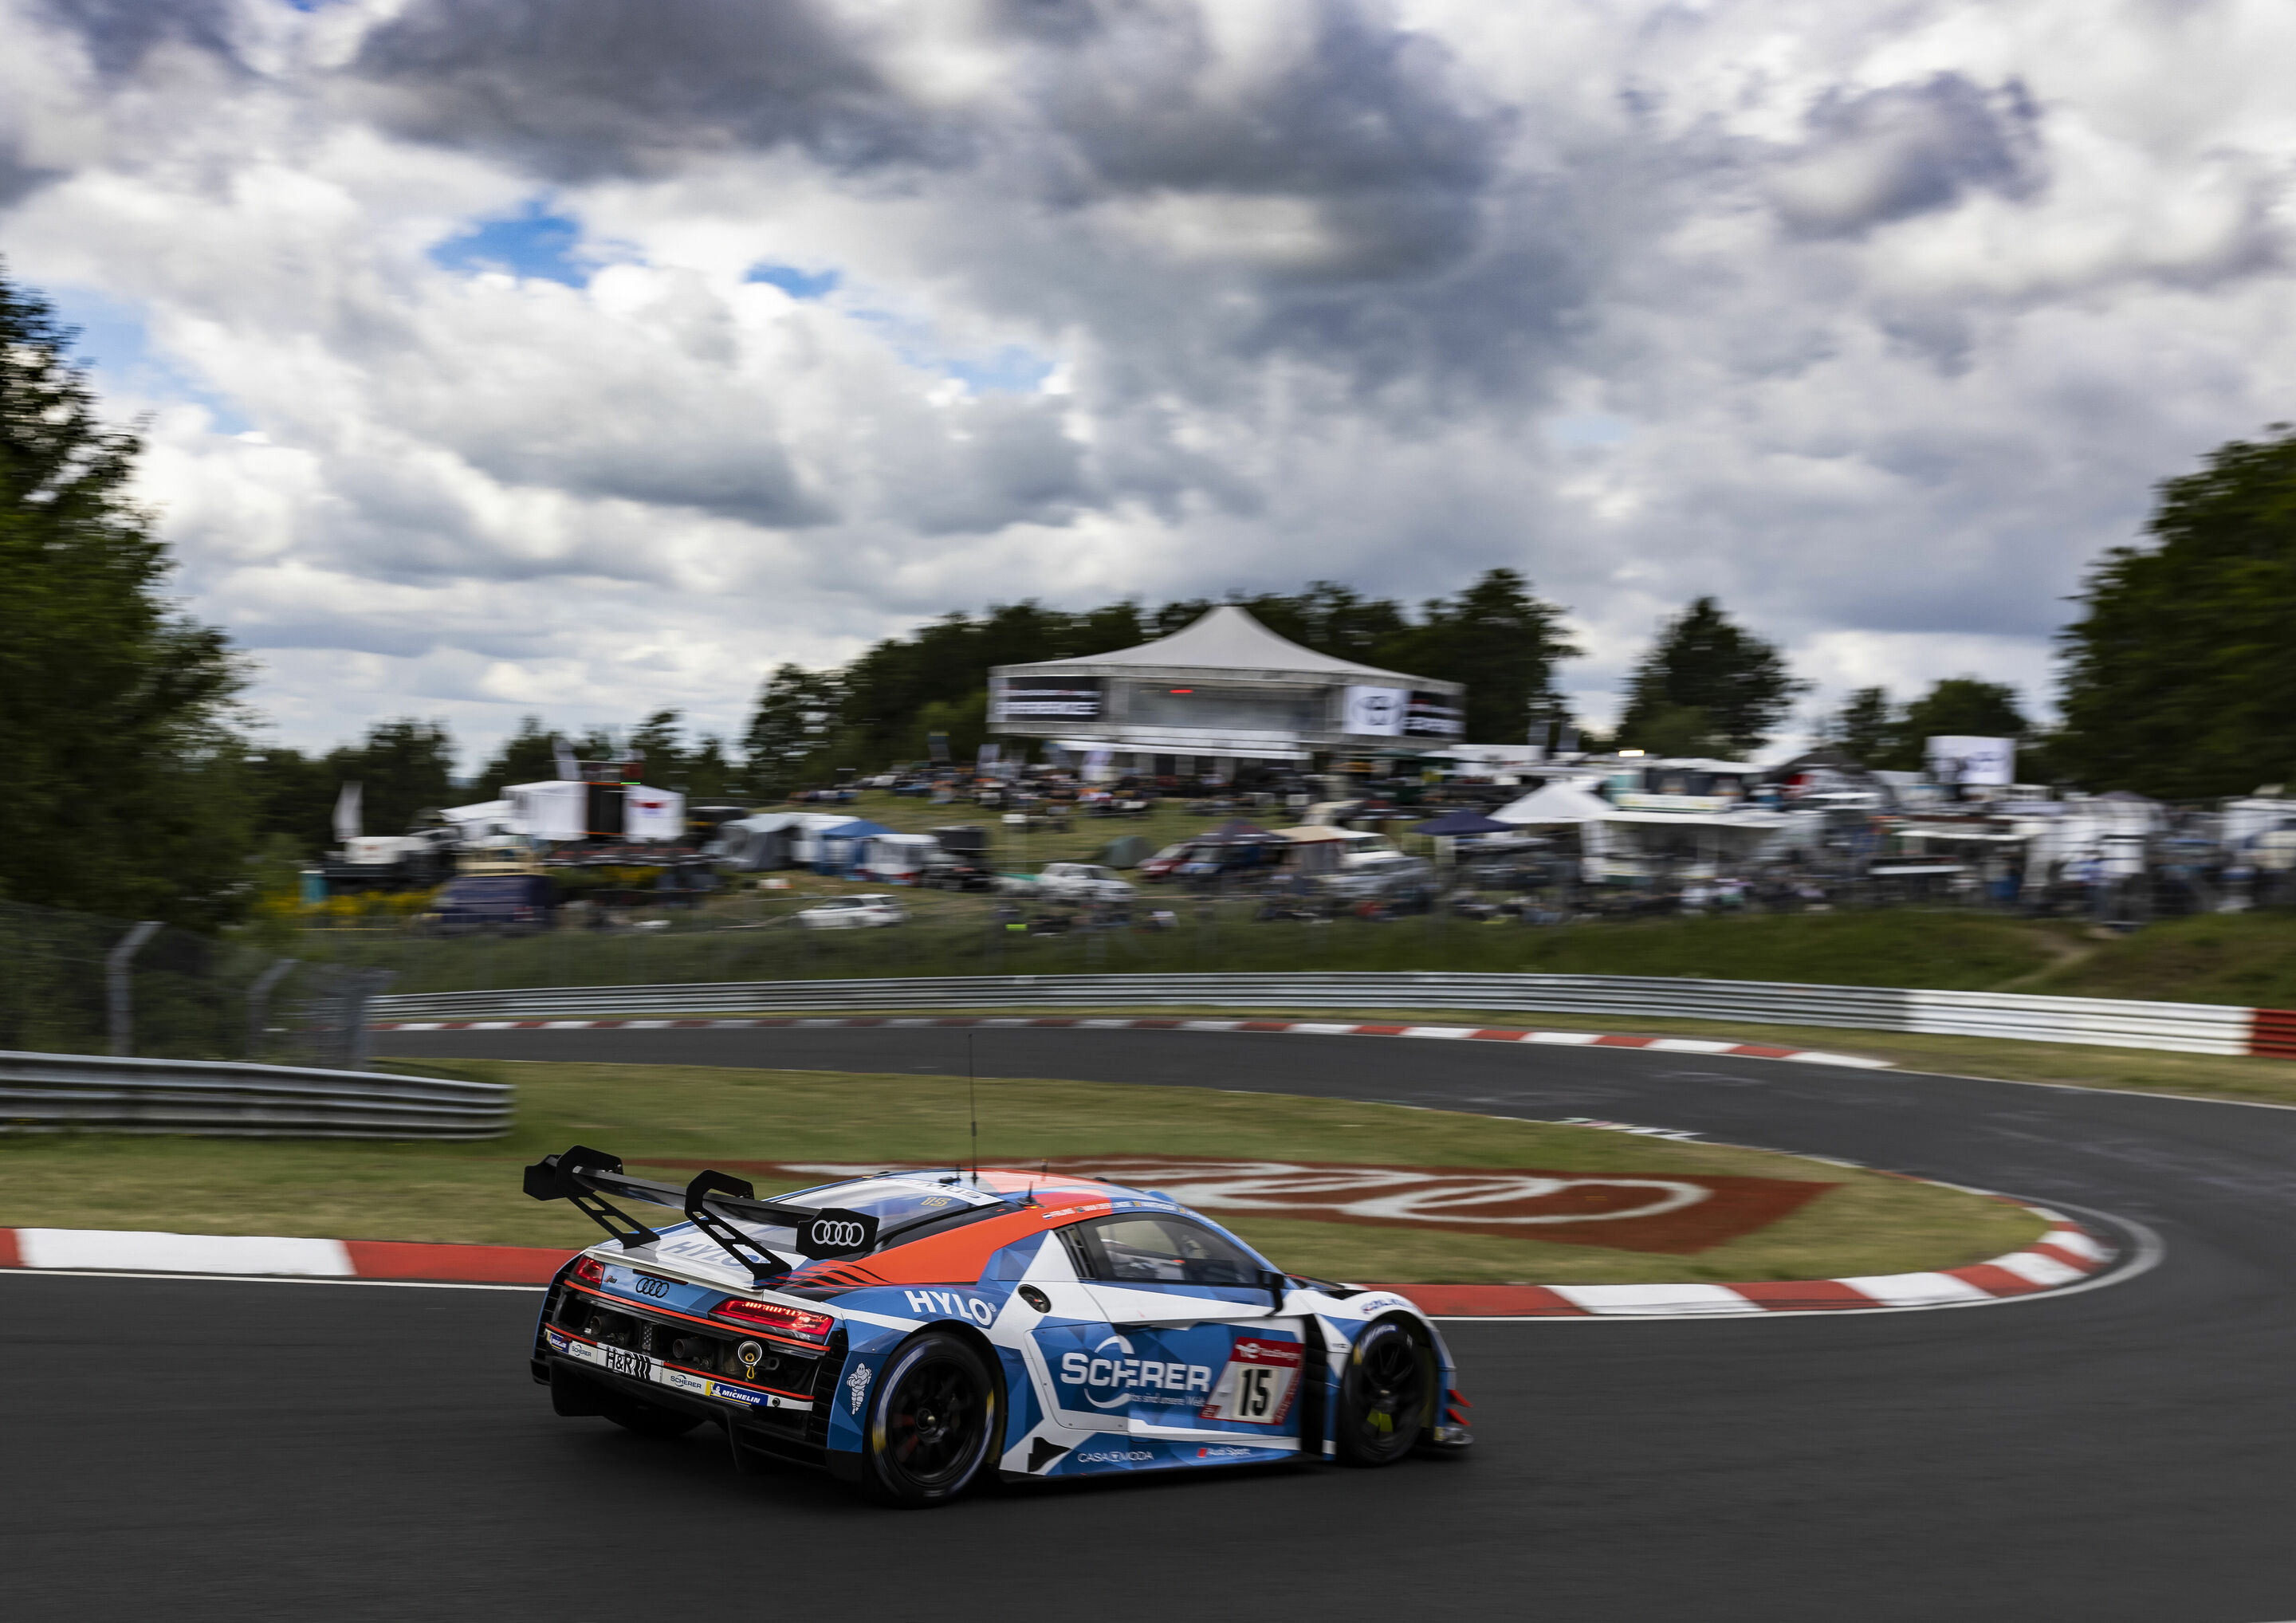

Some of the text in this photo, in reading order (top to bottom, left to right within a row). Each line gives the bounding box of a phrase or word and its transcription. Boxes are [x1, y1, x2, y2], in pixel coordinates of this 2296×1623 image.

[921, 1197, 952, 1207] 15
[572, 1346, 592, 1357] SCHERER
[606, 1346, 634, 1374] H&R
[1060, 1352, 1212, 1392] SCHERER
[670, 1376, 702, 1389] SCHERER
[721, 1390, 761, 1404] MICHELIN
[1238, 1369, 1272, 1416] 15
